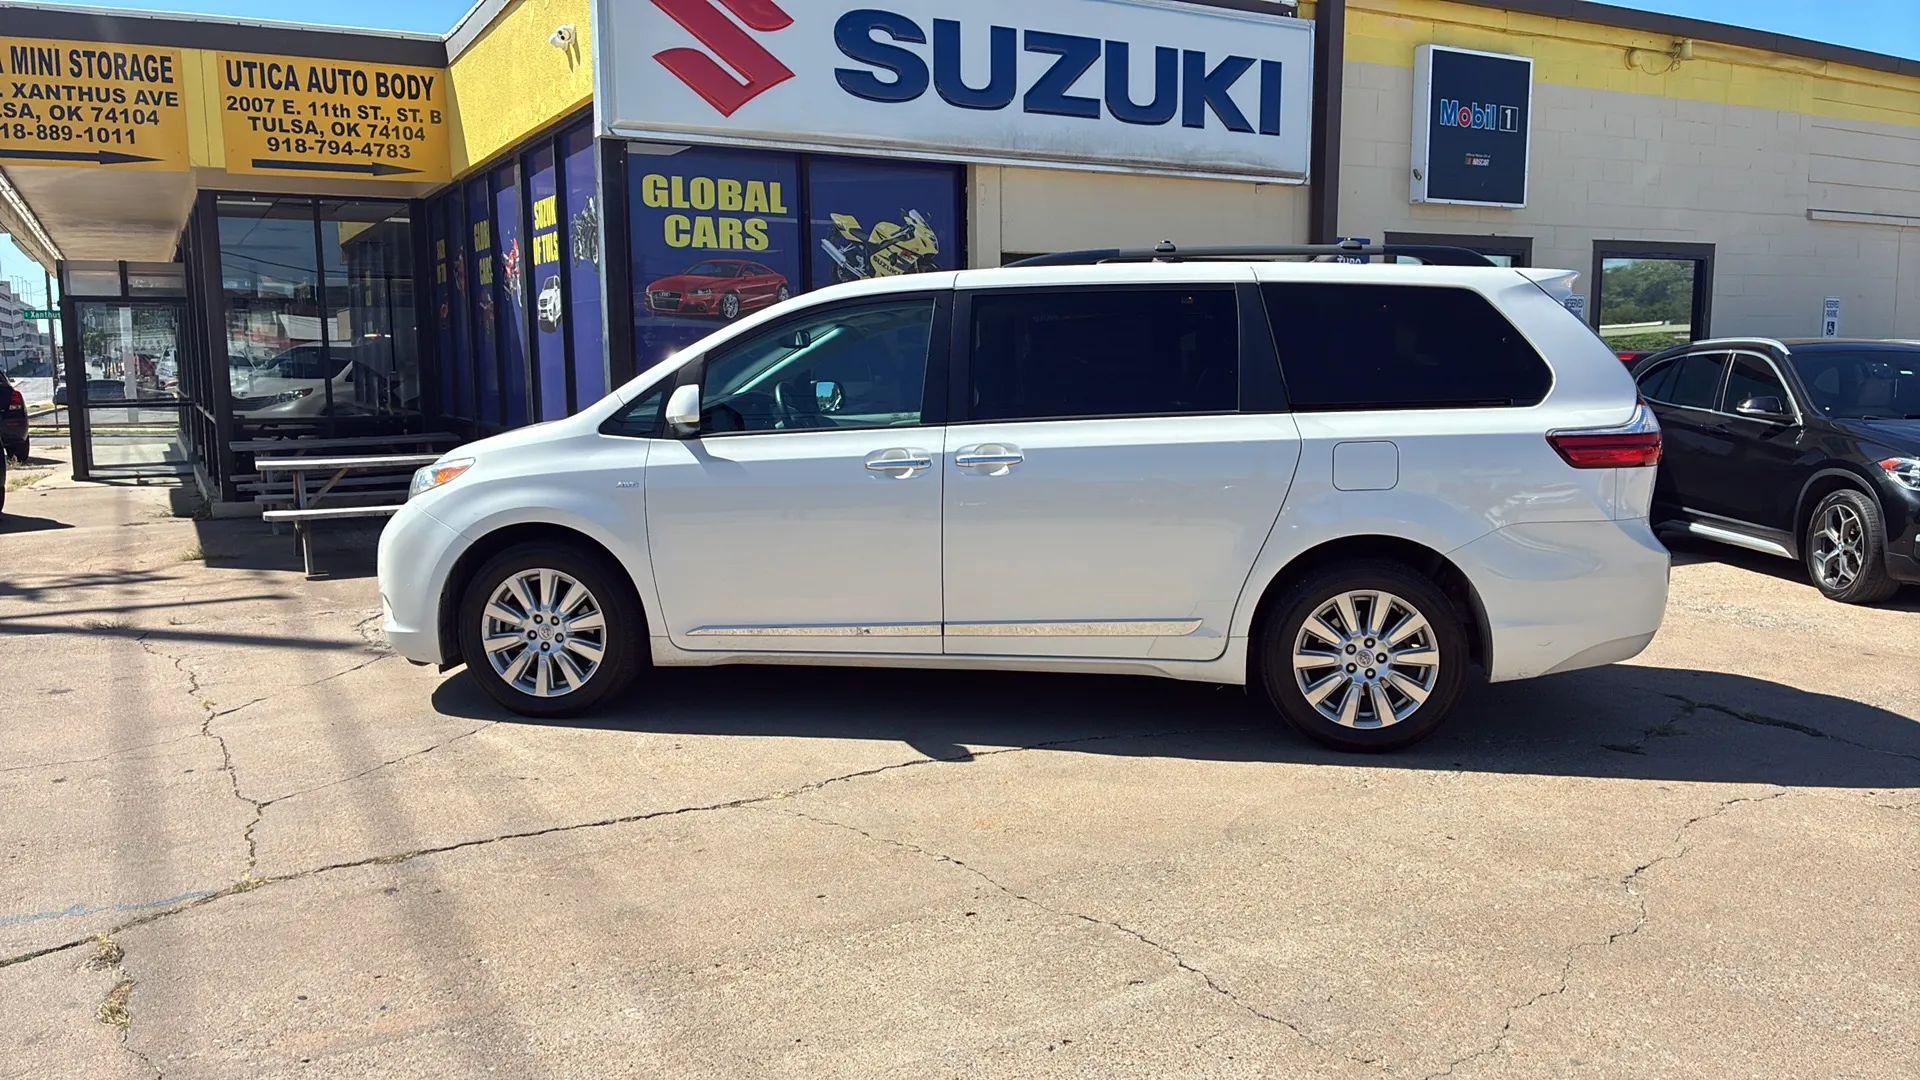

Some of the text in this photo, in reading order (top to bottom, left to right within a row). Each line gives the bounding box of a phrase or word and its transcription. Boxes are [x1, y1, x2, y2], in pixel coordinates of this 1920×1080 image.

[10, 45, 61, 77] MINI
[69, 49, 174, 84] STORAGE
[226, 59, 435, 101] UTICA AUTO BODY
[833, 8, 1283, 137] SUZUKI
[12, 82, 179, 107] XANTHUS AVE
[226, 95, 442, 125] 2007 E. 11th ST., ST. B
[0, 102, 160, 126] SA, OK 74104
[247, 116, 426, 141] TULSA, OK 74104
[1440, 99, 1497, 130] Mobil
[266, 137, 411, 159] 918-794-4783
[641, 174, 788, 215] GLOBAL
[534, 195, 557, 230] SUZUK
[533, 231, 559, 266] OF TULS
[664, 214, 769, 251] CARS
